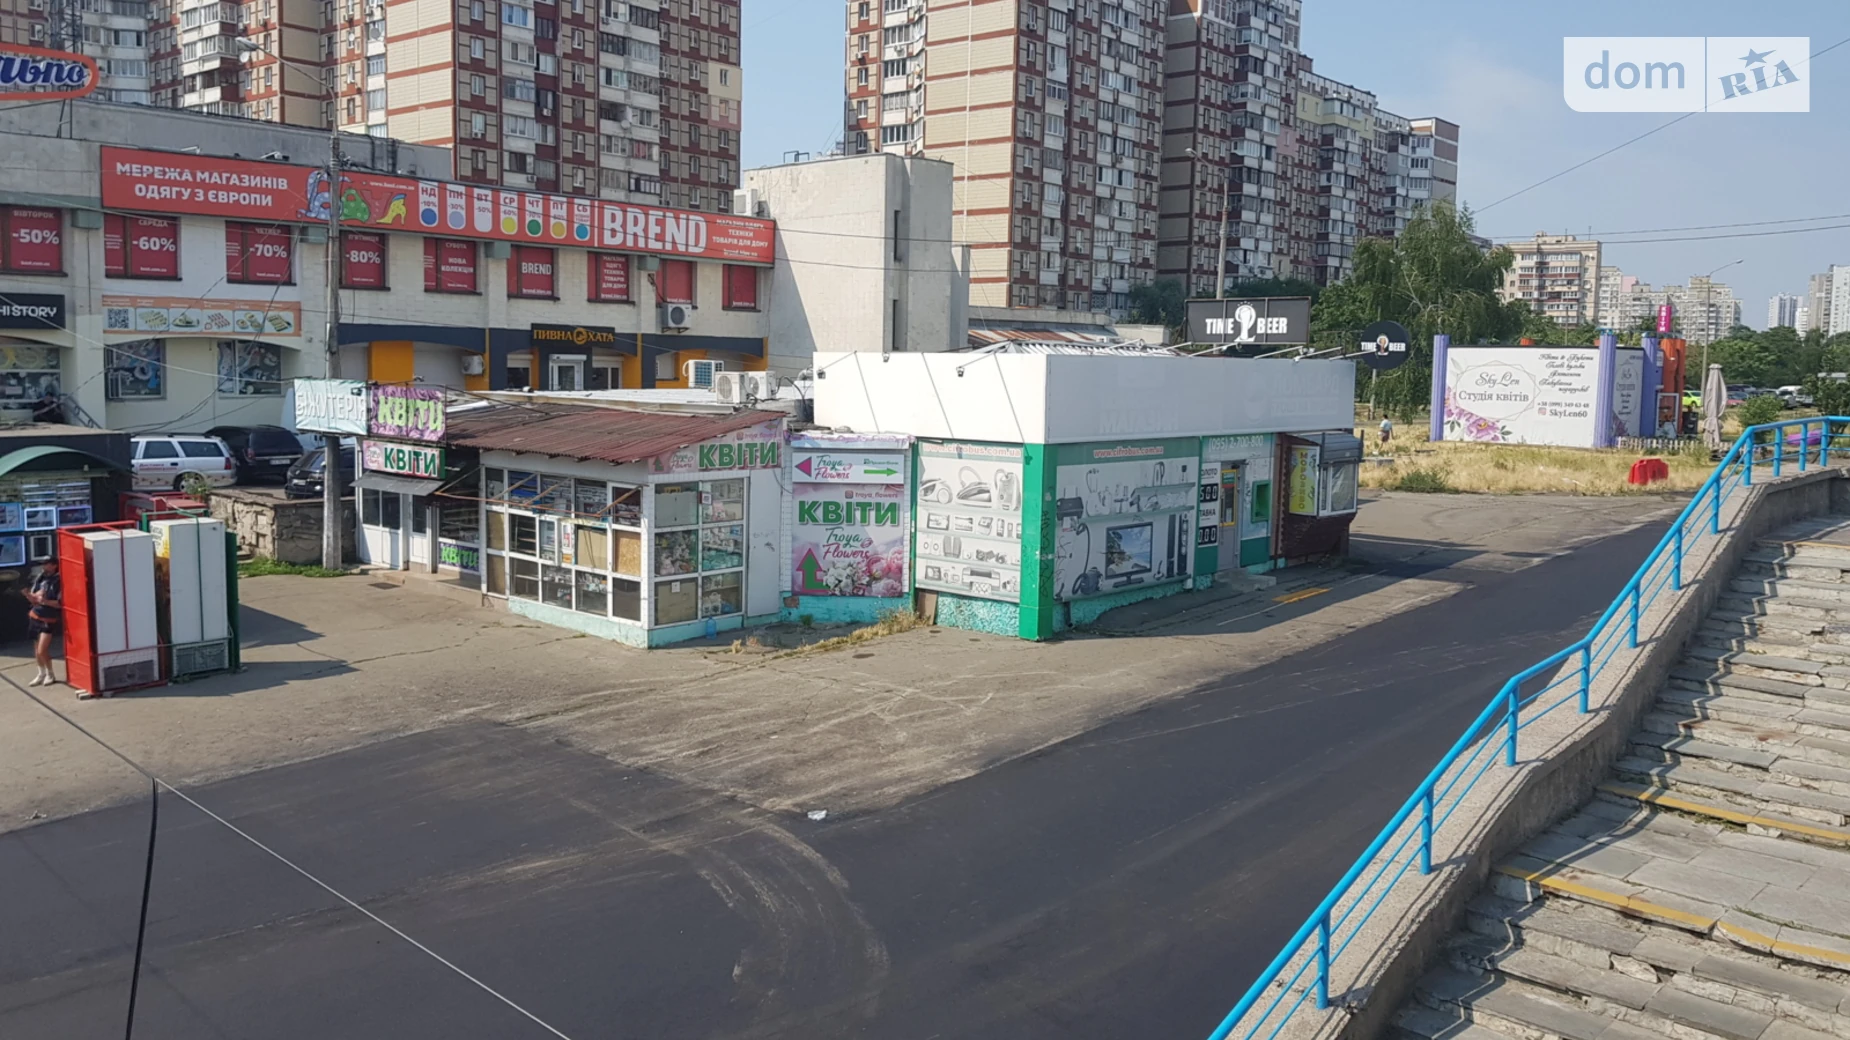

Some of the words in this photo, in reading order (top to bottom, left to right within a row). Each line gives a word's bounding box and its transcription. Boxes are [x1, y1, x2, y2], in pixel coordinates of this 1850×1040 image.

[116, 162, 193, 182] МЕРЕЖА
[196, 171, 288, 190] МАГАЗИНІВ
[134, 184, 191, 200] ОДЯГУ
[194, 190, 204, 201] З
[208, 190, 272, 207] ЄВРОПИ
[421, 187, 437, 198] НД
[448, 191, 463, 200] ПН
[476, 193, 490, 202] ВТ
[503, 196, 516, 205] СР
[527, 199, 540, 208] ЧТ
[552, 202, 565, 210] ПТ
[13, 210, 55, 219] ВІВТОРОК
[576, 204, 588, 213] СБ
[138, 219, 168, 227] СЕРЕДА
[603, 205, 707, 253] BREND
[12, 229, 60, 244] -50%
[712, 236, 738, 245] ТОВАРІВ
[751, 240, 768, 248] ДОМУ
[132, 237, 175, 251] -60%
[250, 244, 287, 258] -70%
[345, 251, 380, 264] -80%
[521, 262, 552, 275] BREND
[1205, 318, 1234, 334] TIME
[1256, 317, 1288, 334] BEER
[533, 329, 572, 340] ПИВНА
[588, 332, 615, 342] ХАТА
[1361, 341, 1377, 351] TIME
[1388, 341, 1406, 351] BEER
[1459, 391, 1493, 402] Студія
[1496, 391, 1529, 402] квітів
[378, 396, 443, 431] КВІТИ
[1549, 409, 1588, 419] SkyLen60
[923, 443, 1021, 457] www.cifrobus.com.ua
[1209, 437, 1228, 452] (095)
[698, 441, 778, 469] КВІТИ
[1093, 446, 1164, 458] www.cifrobus.com.ua
[384, 447, 437, 477] КВІТИ
[816, 455, 844, 471] Troya
[814, 466, 850, 480] Flowers
[798, 500, 899, 526] КВІТИ
[825, 526, 861, 548] Troya
[822, 542, 870, 560] Flowers
